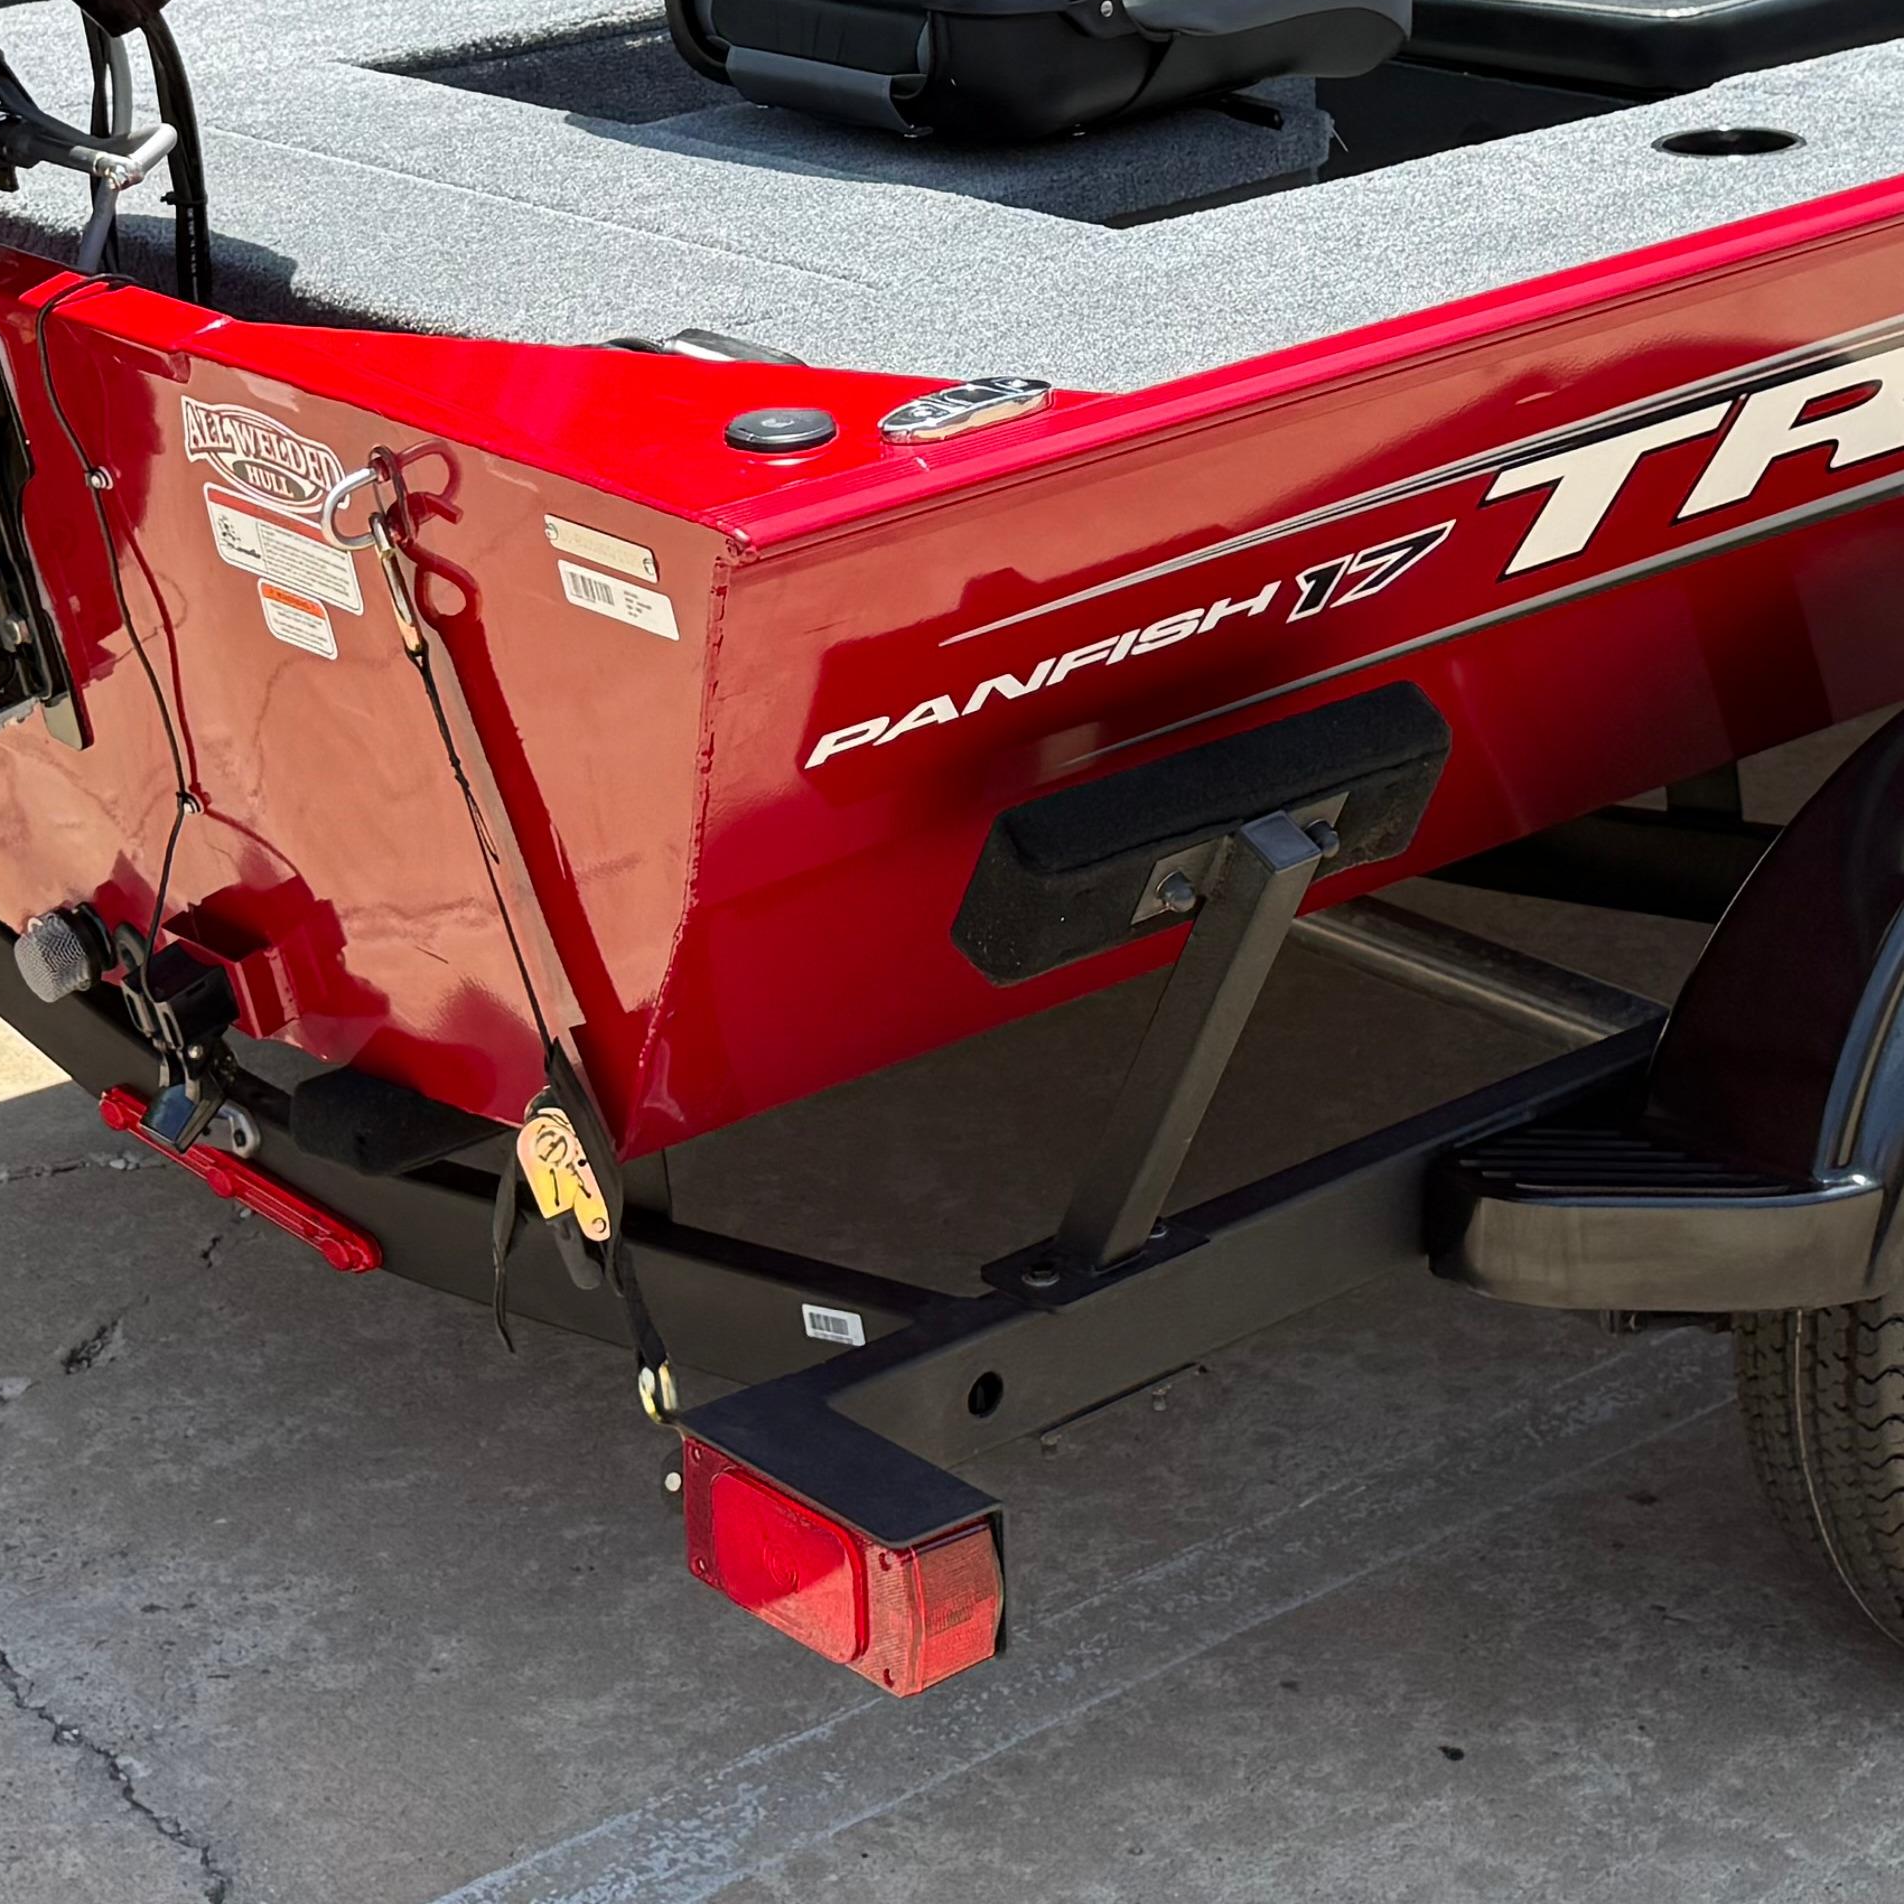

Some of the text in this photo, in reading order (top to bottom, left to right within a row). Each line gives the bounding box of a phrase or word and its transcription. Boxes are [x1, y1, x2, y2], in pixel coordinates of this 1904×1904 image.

[186, 402, 345, 492] ALL WELDED
[244, 462, 295, 498] HULL
[804, 518, 1458, 770] PANFISH 17
